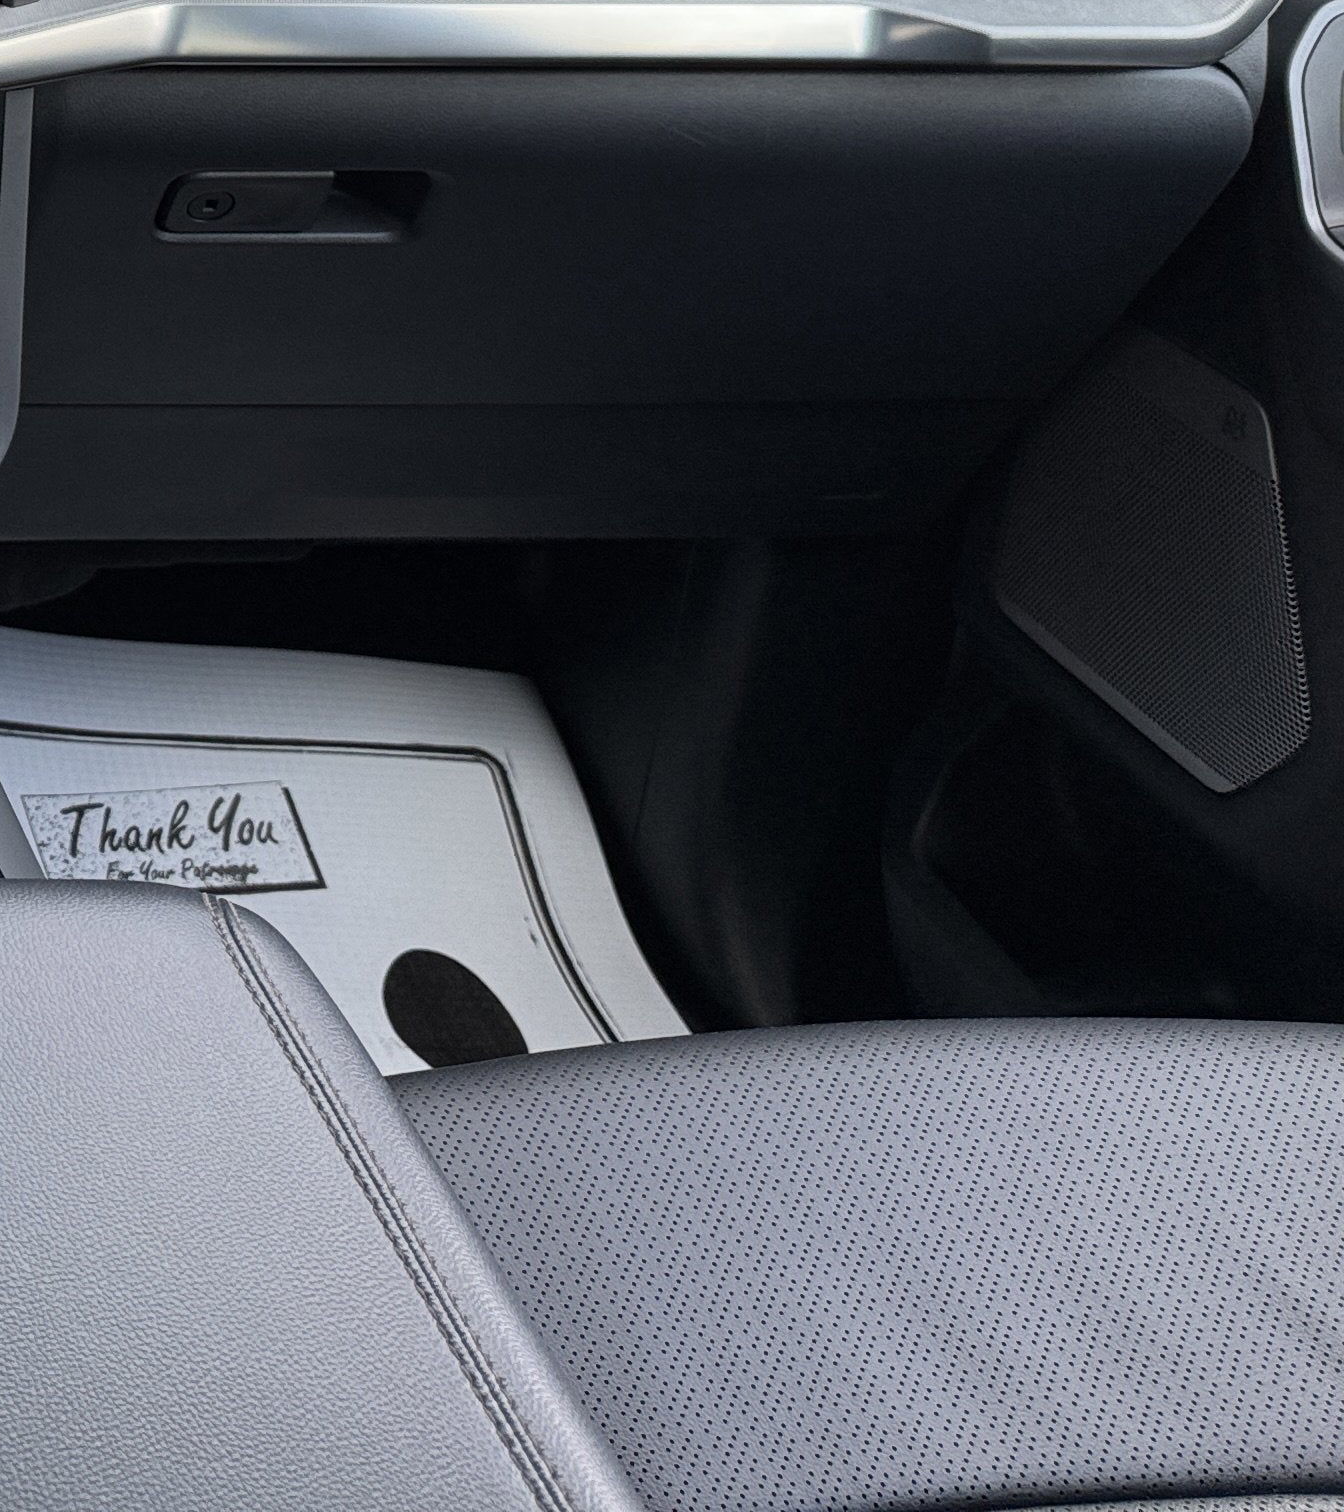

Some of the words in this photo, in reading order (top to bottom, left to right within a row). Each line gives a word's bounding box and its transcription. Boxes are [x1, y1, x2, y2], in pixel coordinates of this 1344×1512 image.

[60, 799, 196, 857] Thank
[208, 793, 280, 848] You
[107, 860, 135, 880] For
[140, 859, 176, 880] Your
